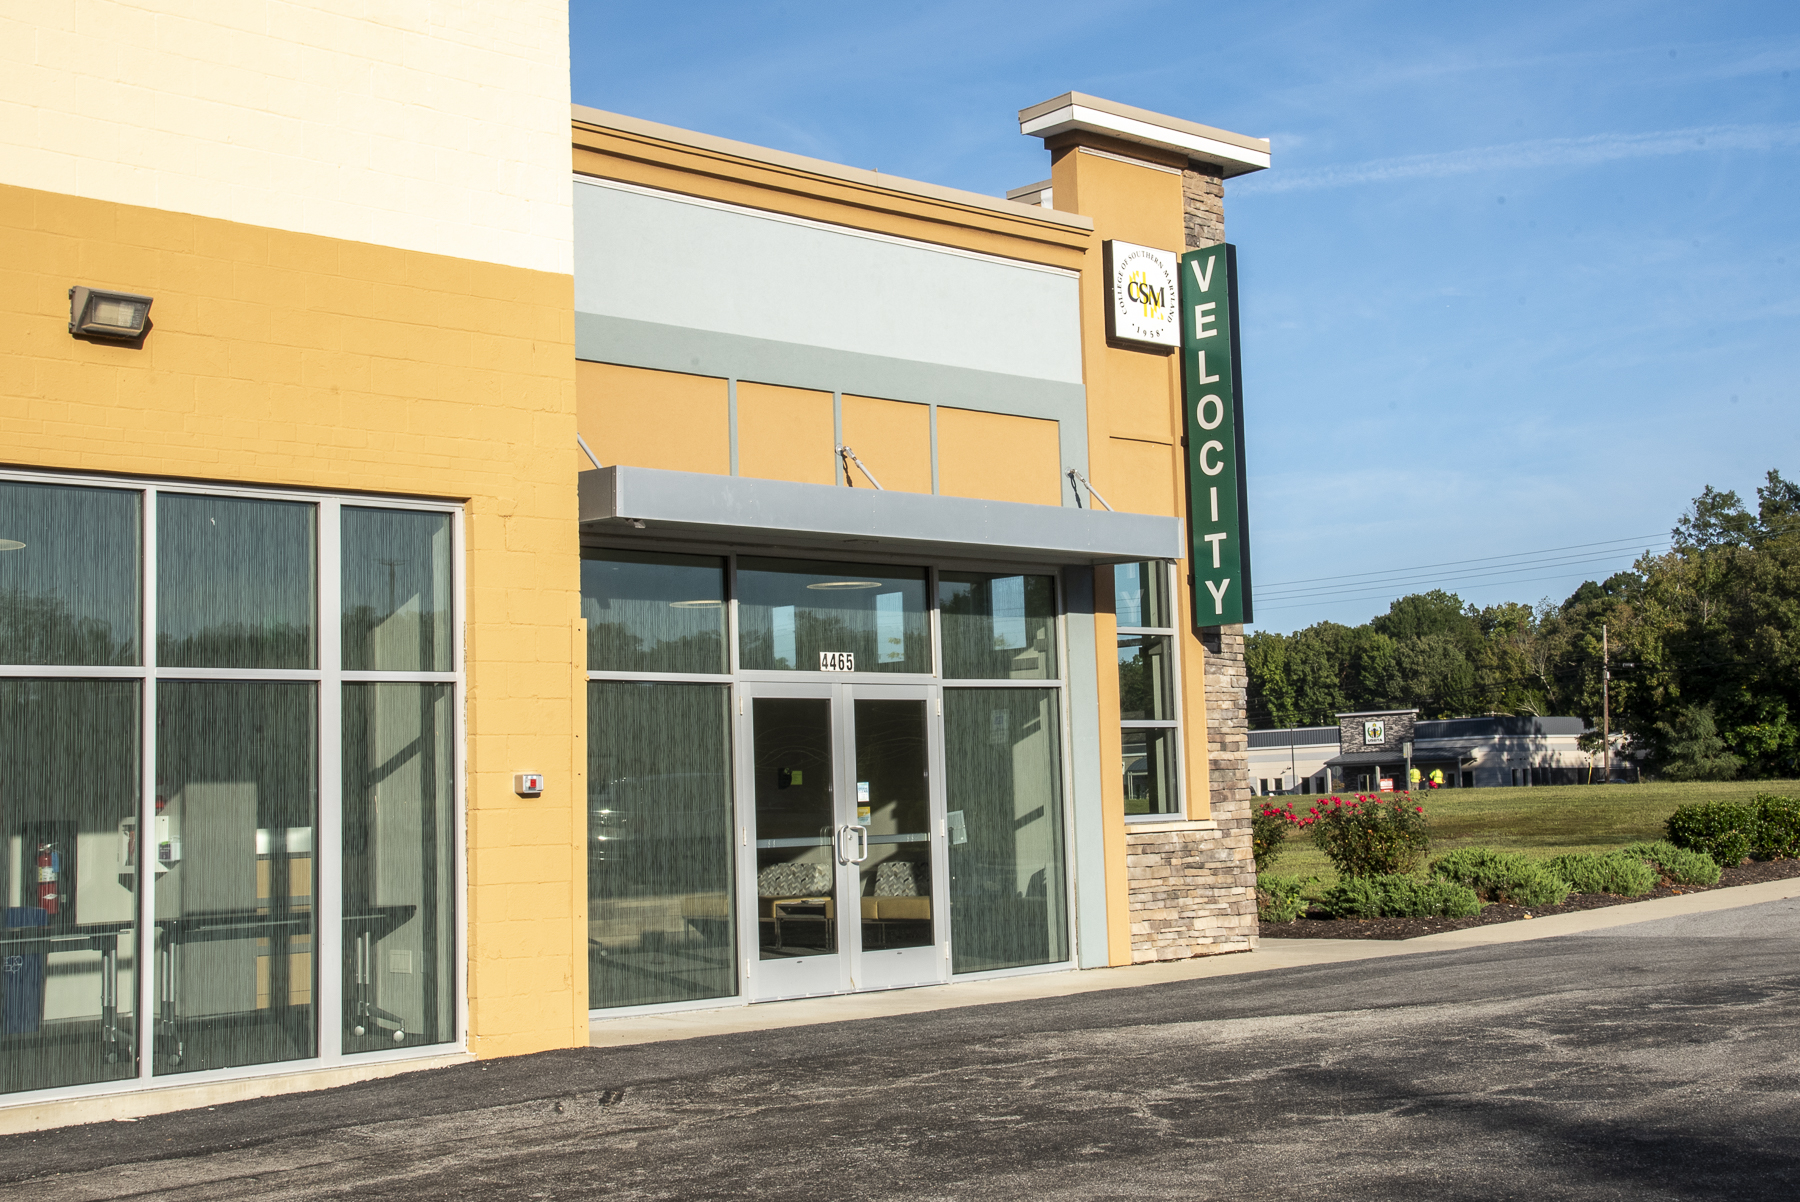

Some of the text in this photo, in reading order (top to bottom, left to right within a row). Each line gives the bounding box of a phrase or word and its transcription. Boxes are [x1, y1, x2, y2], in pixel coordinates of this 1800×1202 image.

[1117, 250, 1175, 323] COLLEGE OF SOUTHERN MARYLAND
[1127, 281, 1165, 308] CSM
[1136, 326, 1161, 339] 1958
[1190, 255, 1231, 615] VELOCITY
[821, 653, 853, 671] 4465
